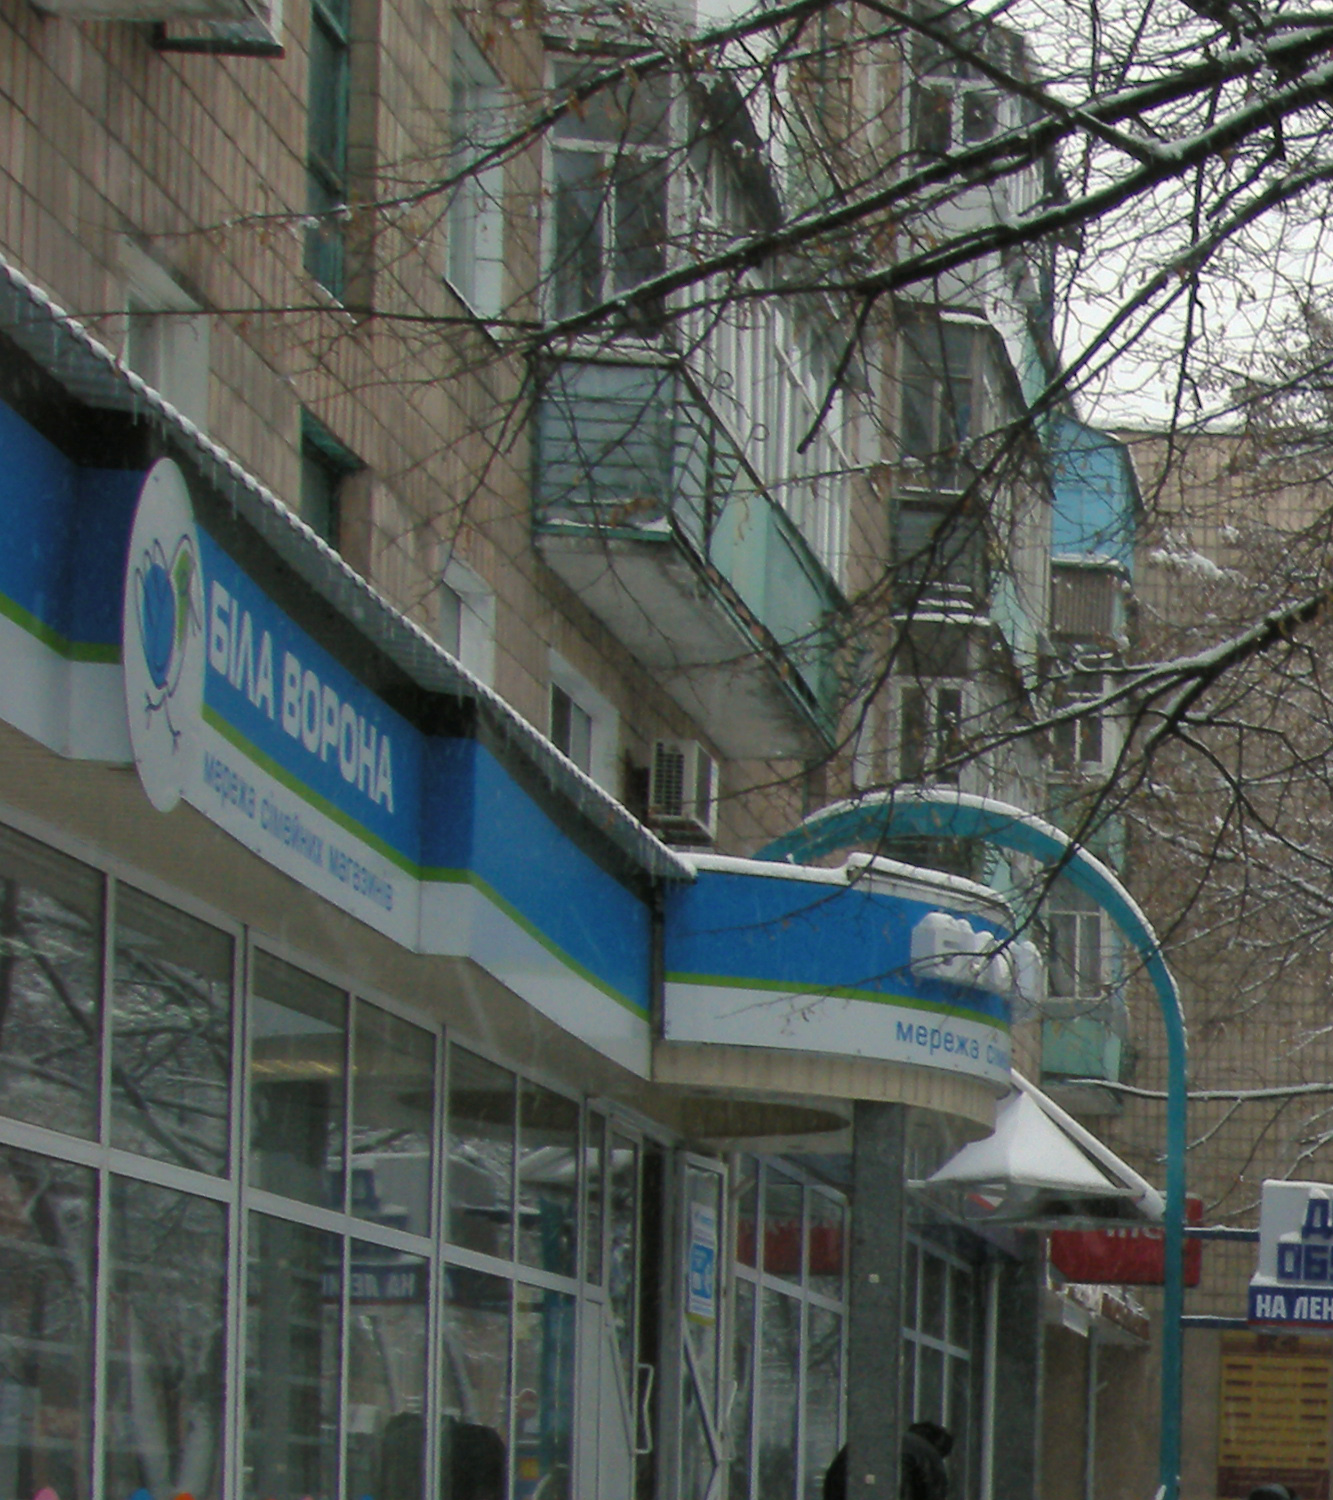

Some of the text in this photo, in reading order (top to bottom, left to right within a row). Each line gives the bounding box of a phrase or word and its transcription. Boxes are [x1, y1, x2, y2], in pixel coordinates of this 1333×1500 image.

[209, 580, 394, 814] БІЛА ВОРОНА
[895, 1020, 980, 1059] мережа
[1255, 1294, 1288, 1319] НА
